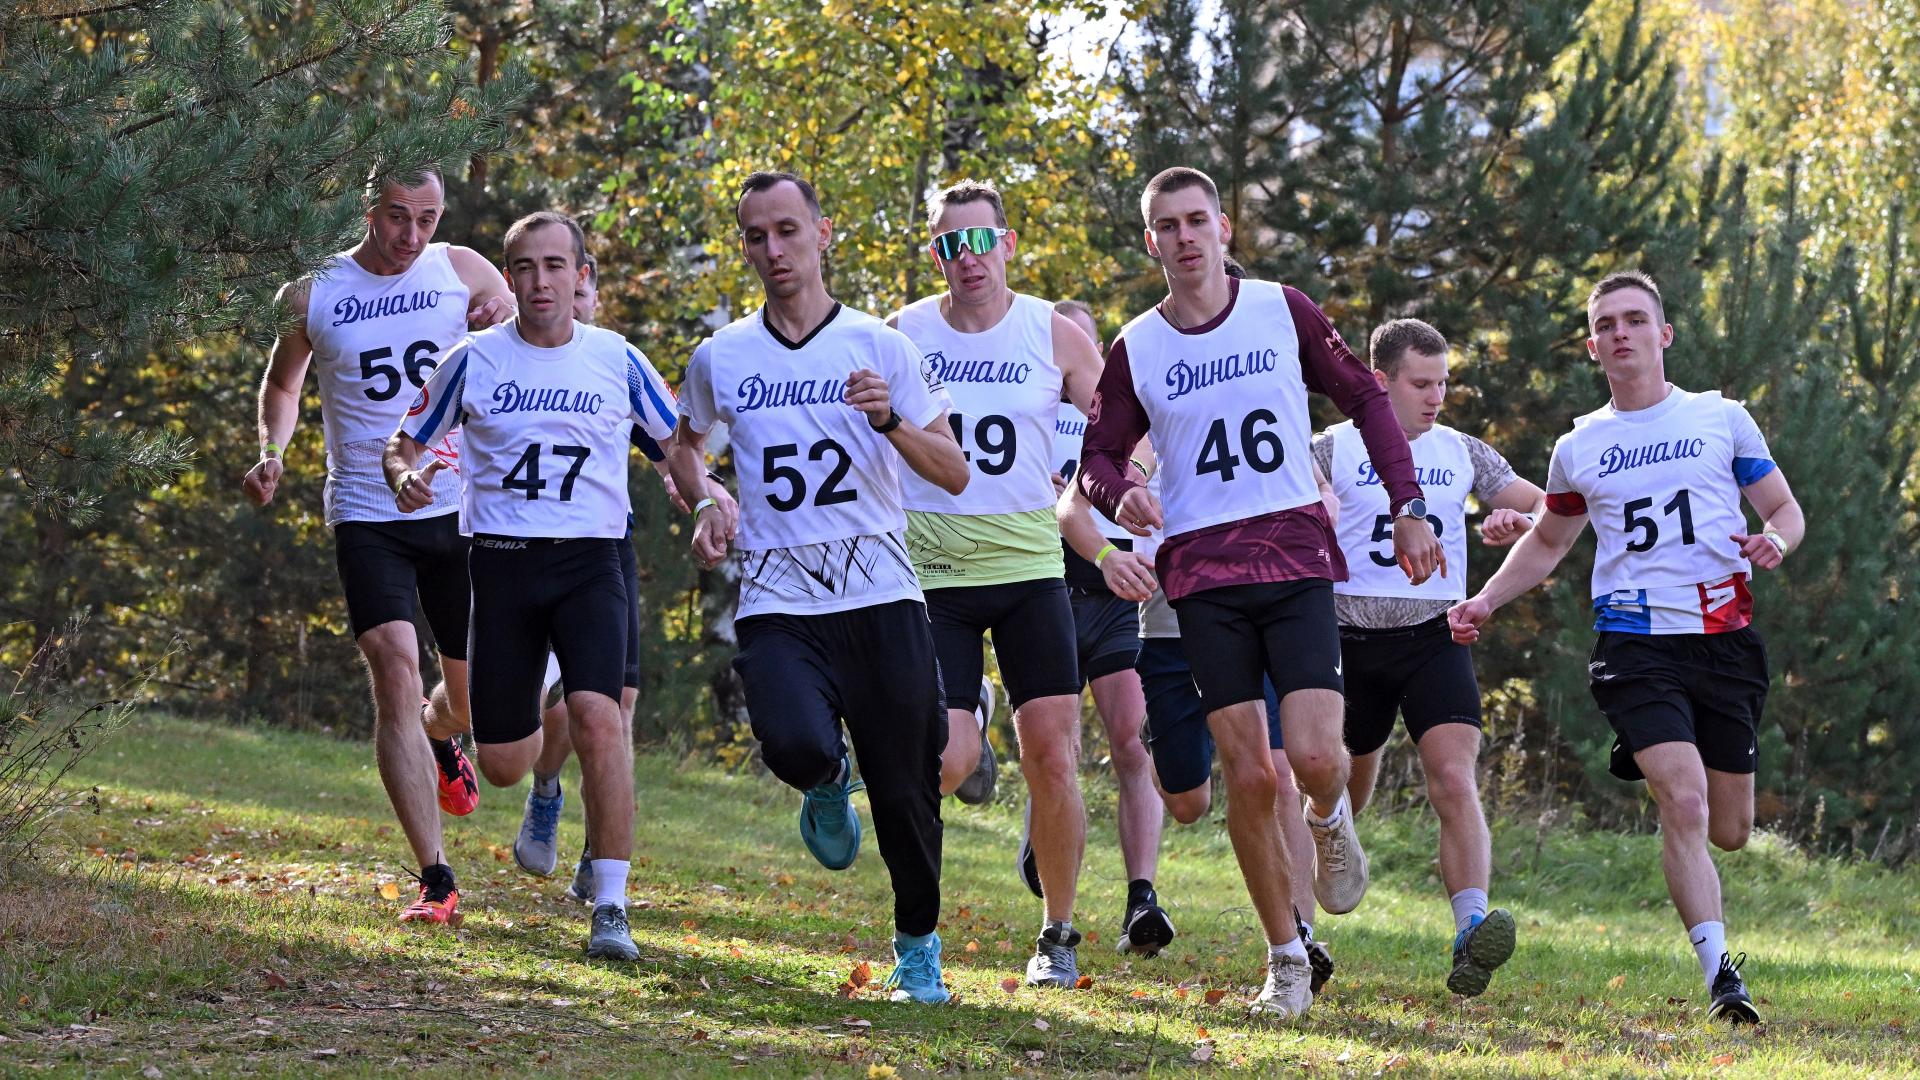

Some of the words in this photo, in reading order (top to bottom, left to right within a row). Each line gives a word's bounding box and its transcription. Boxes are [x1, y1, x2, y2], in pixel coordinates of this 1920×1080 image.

[332, 289, 442, 328] Динамо
[359, 340, 440, 402] 56
[490, 379, 605, 416] Динамо
[1165, 348, 1279, 401] Динамо
[501, 444, 591, 502] 47
[1196, 409, 1285, 482] 46
[1597, 438, 1706, 479] Динамо
[763, 438, 859, 512] 52
[474, 537, 529, 550] DEMIX
[1623, 489, 1696, 553] 51
